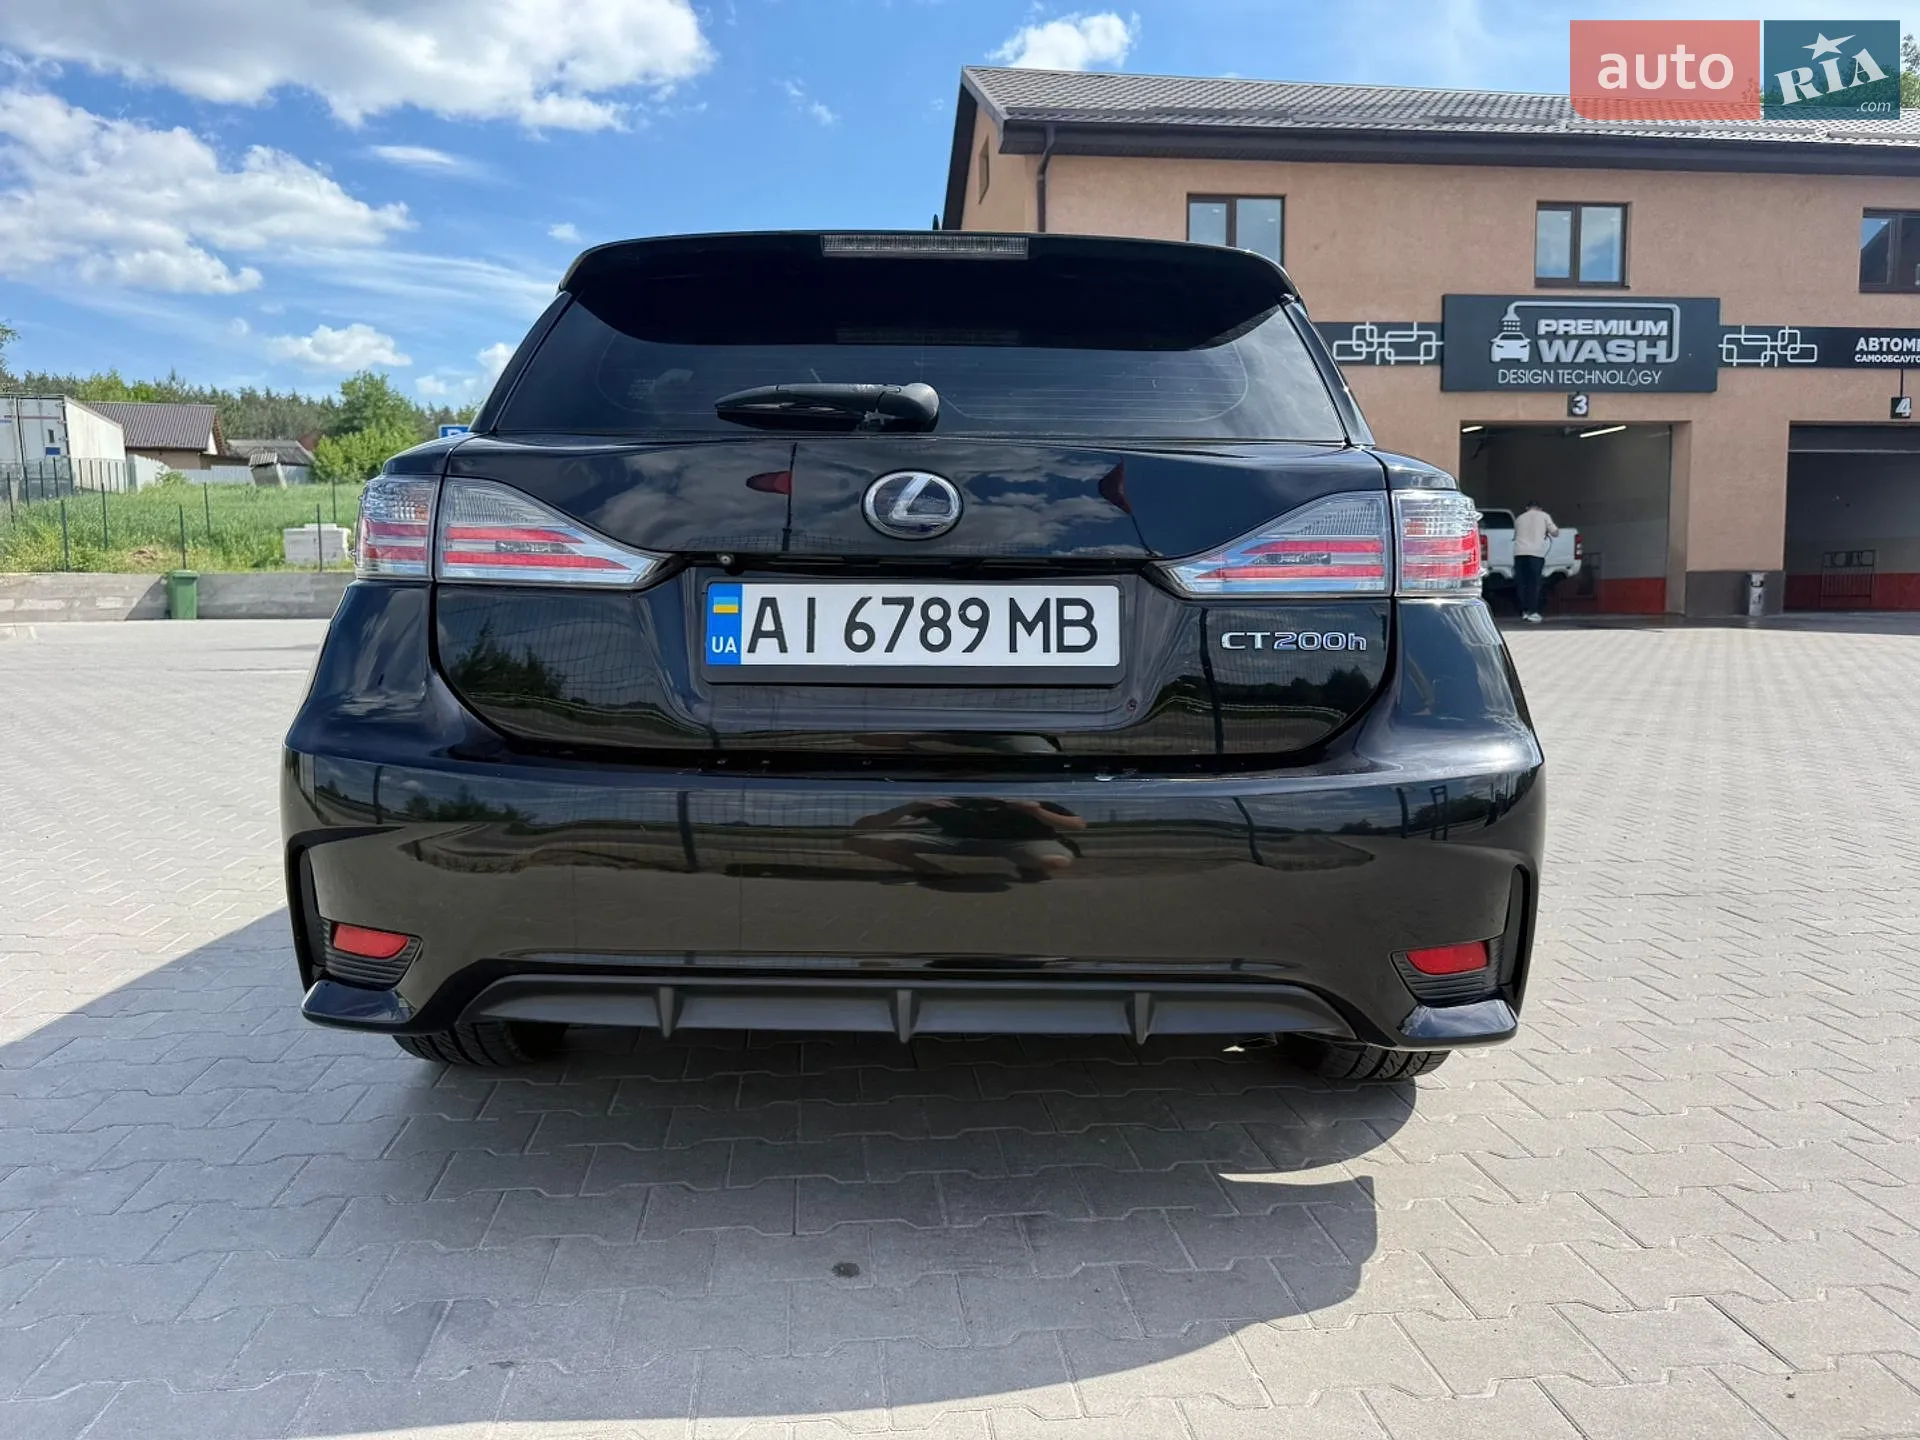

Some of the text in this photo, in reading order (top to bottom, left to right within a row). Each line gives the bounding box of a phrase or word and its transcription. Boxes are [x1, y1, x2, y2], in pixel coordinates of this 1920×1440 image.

[1537, 319, 1669, 336] PREMIUM
[1537, 339, 1672, 364] WASH
[1855, 337, 1920, 352] АВТОМ
[1498, 369, 1554, 384] DESIGN
[1573, 396, 1588, 415] 3
[1895, 398, 1912, 417] 4
[747, 596, 1099, 654] AI 6789 MB
[711, 636, 738, 654] UA
